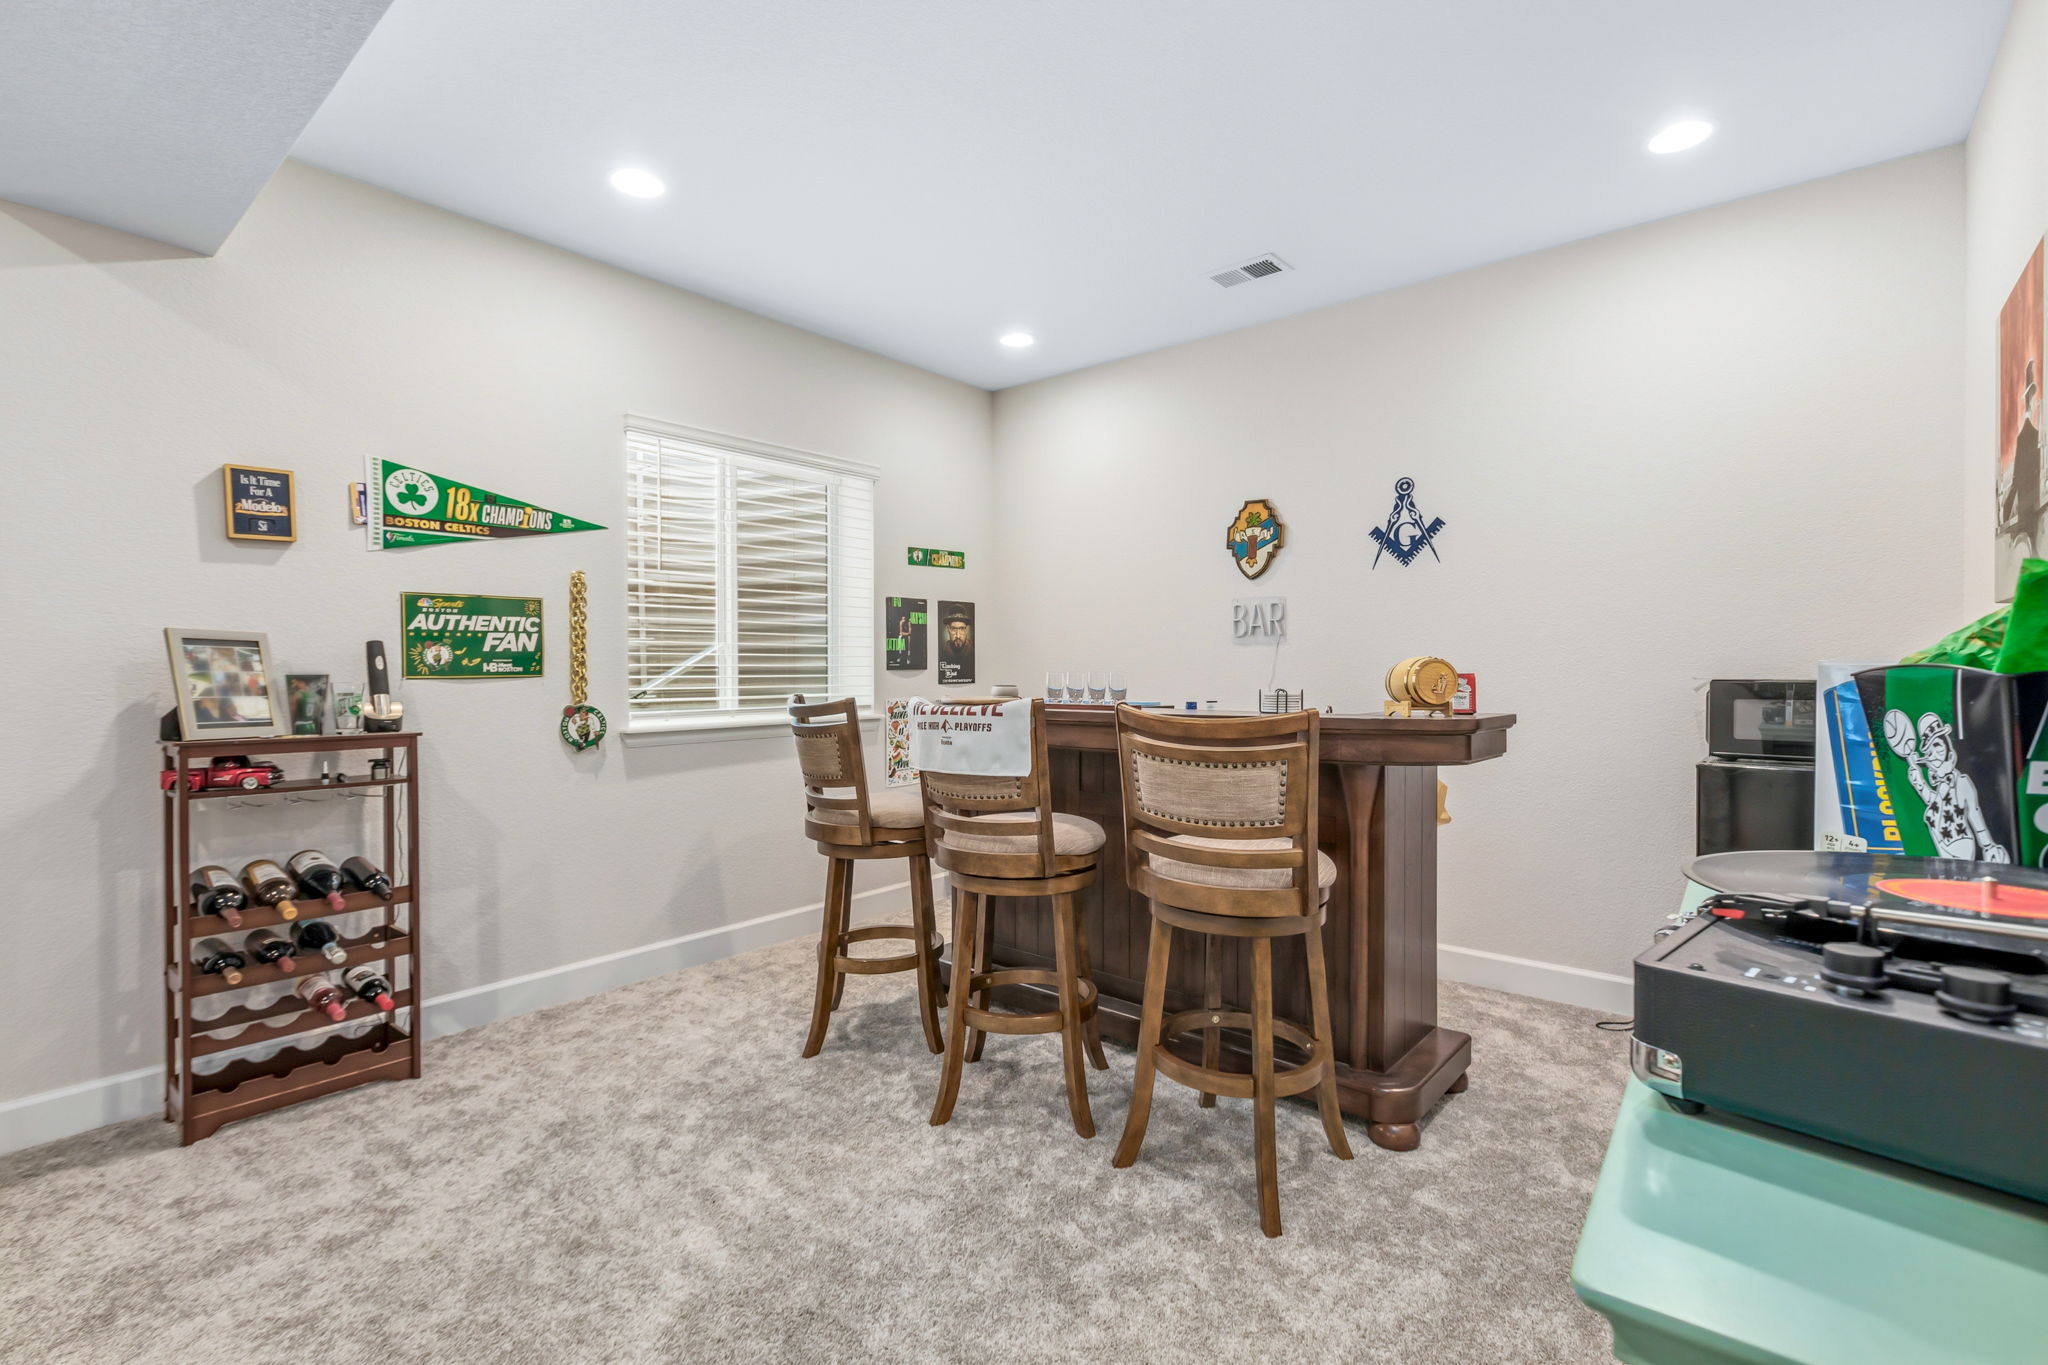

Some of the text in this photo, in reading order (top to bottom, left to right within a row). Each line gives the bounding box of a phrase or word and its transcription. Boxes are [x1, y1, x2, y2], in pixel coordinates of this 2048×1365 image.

[240, 474, 249, 484] Is
[257, 476, 281, 488] Time
[389, 471, 435, 493] CELTICS
[249, 486, 274, 497] For A
[241, 498, 282, 513] Modelo
[385, 516, 490, 535] BOSTON CELTICS
[1394, 522, 1421, 547] G
[407, 613, 541, 633] AUTHENTIC
[1232, 602, 1284, 639] BAR
[482, 632, 539, 653] FAN
[954, 722, 992, 733] PLAYOFFS
